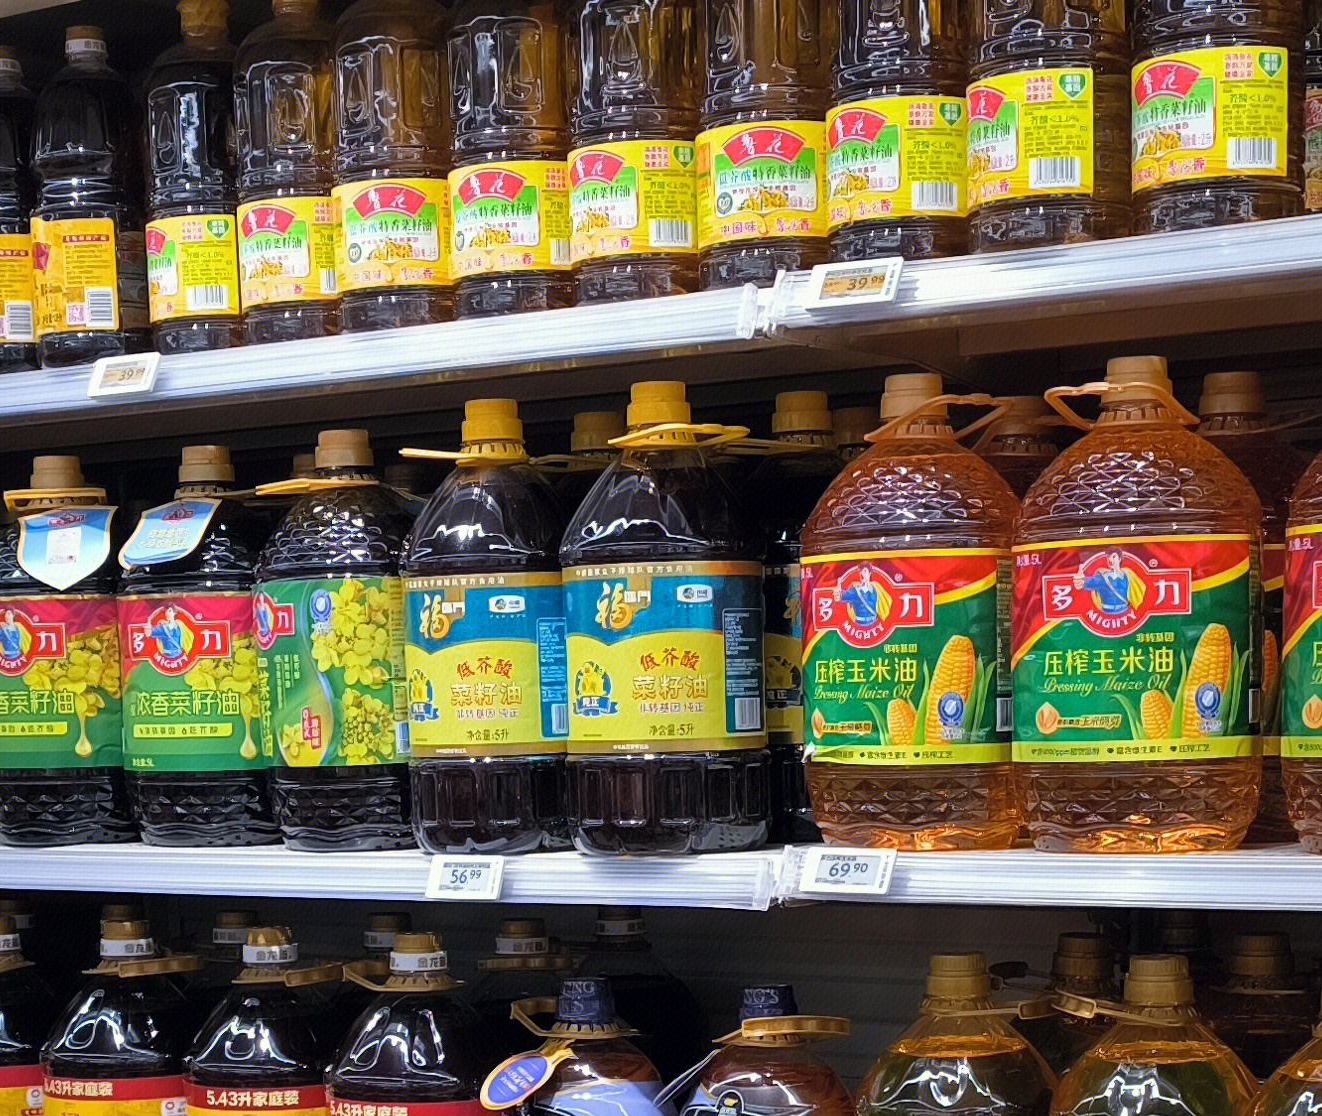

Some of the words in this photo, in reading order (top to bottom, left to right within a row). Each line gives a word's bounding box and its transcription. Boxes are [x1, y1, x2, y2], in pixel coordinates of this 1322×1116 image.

[739, 132, 785, 156] 鲁花
[366, 187, 408, 210] 鲁花
[1086, 608, 1136, 629] MIGHTY
[841, 621, 885, 640] MIGHTY
[456, 657, 512, 678] 低芥酸
[639, 648, 700, 671] 低芥酸
[1044, 649, 1174, 675] 压榨玉米油
[815, 660, 917, 685] 压榨玉米油
[450, 682, 522, 707] 菜籽油
[632, 675, 708, 700] 菜籽油
[135, 690, 240, 717] 浓香菜籽油
[206, 1091, 299, 1107] 5.43升家庭装
